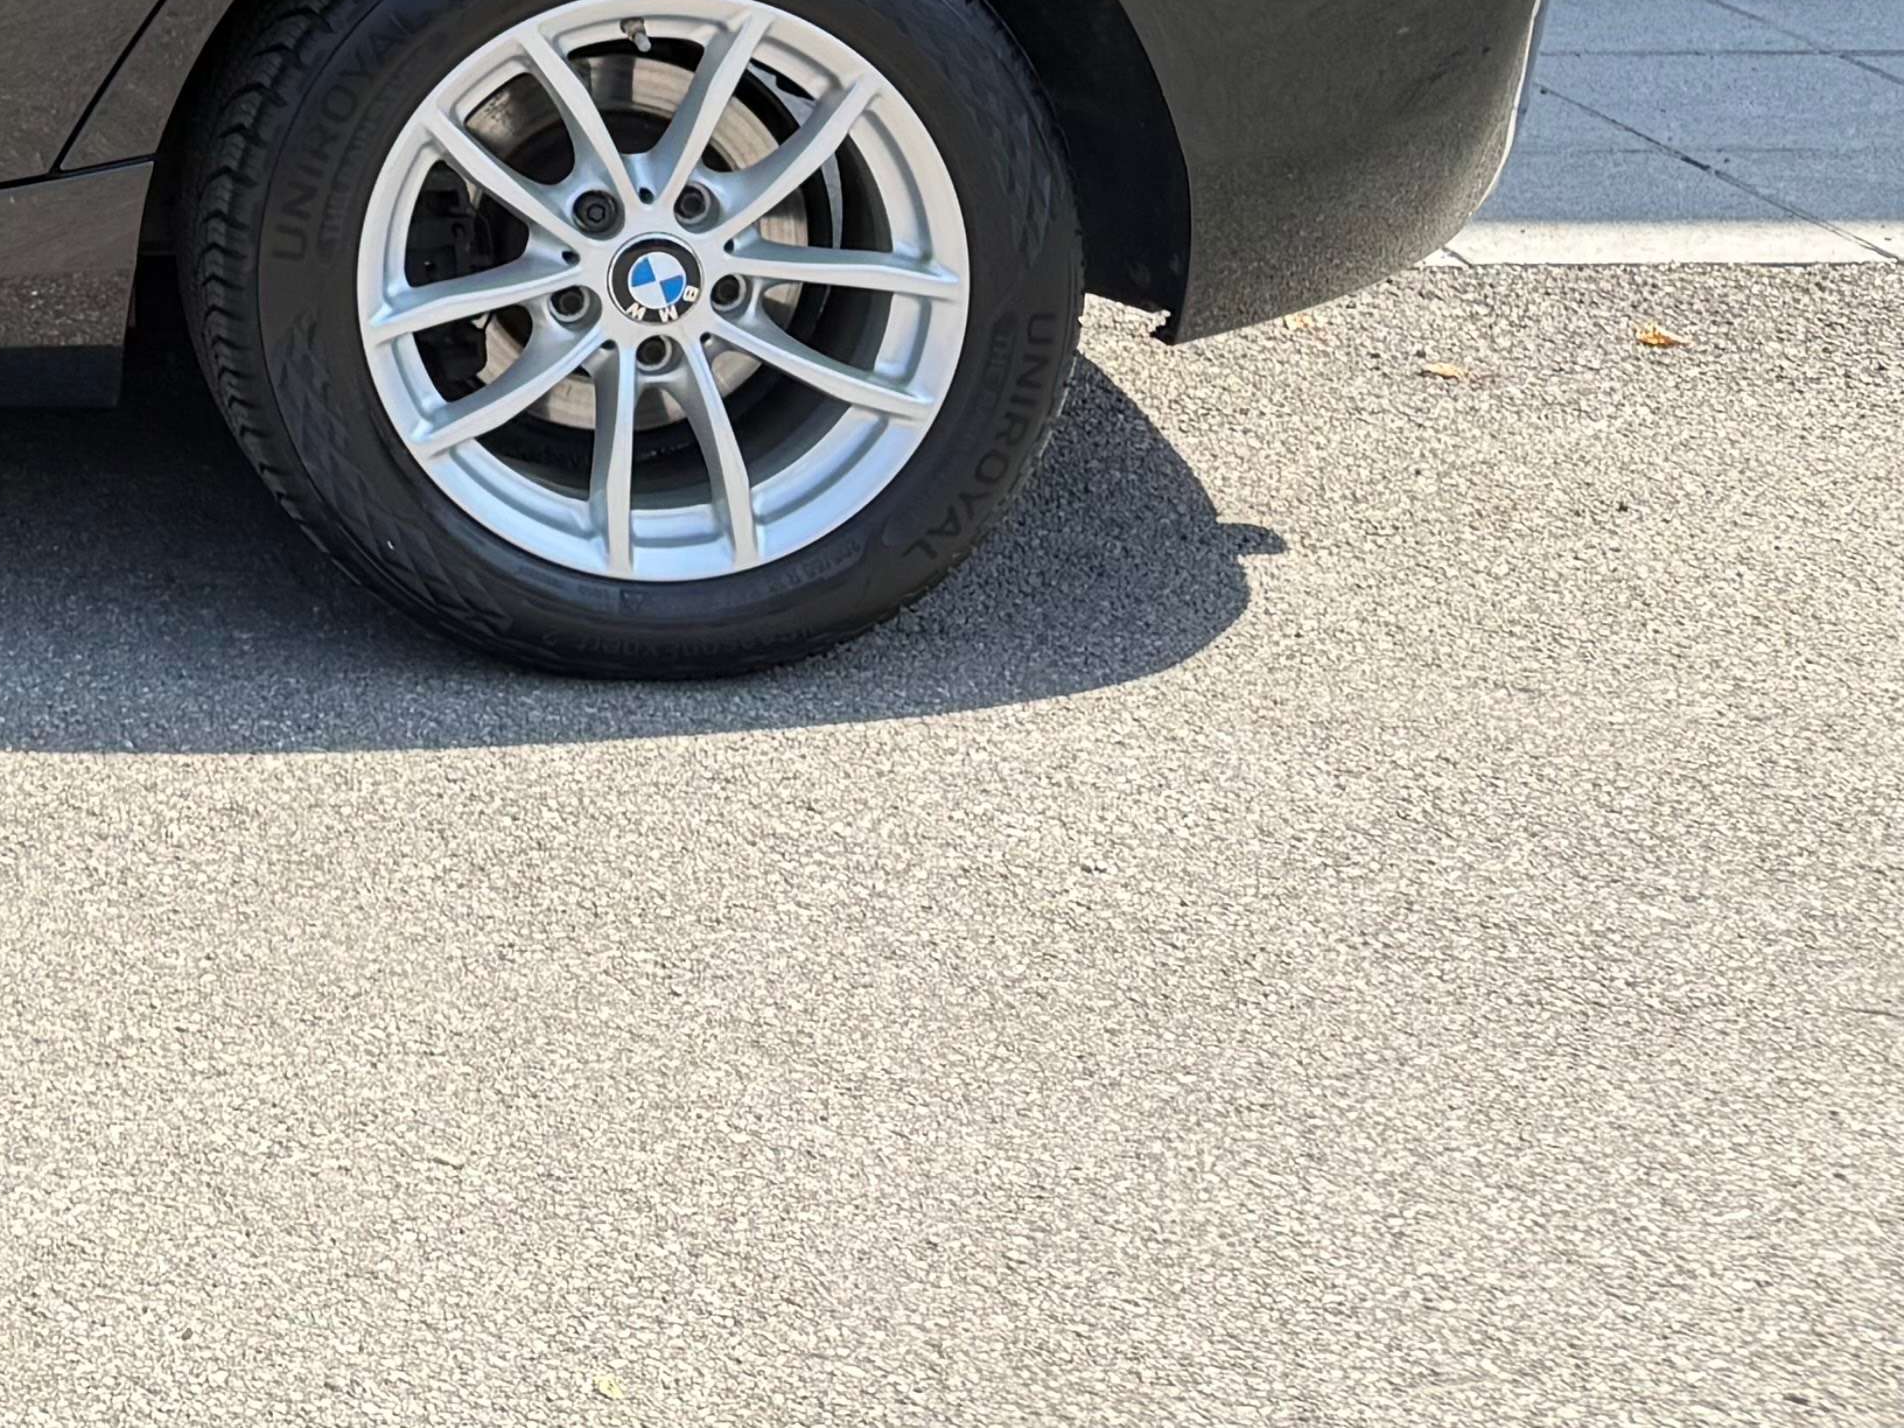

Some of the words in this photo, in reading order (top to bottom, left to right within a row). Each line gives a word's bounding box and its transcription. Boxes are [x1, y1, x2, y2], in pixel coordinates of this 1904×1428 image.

[272, 11, 430, 261] UNIROYAL
[625, 284, 700, 323] BMW
[901, 312, 1057, 560] UNIROYAL
